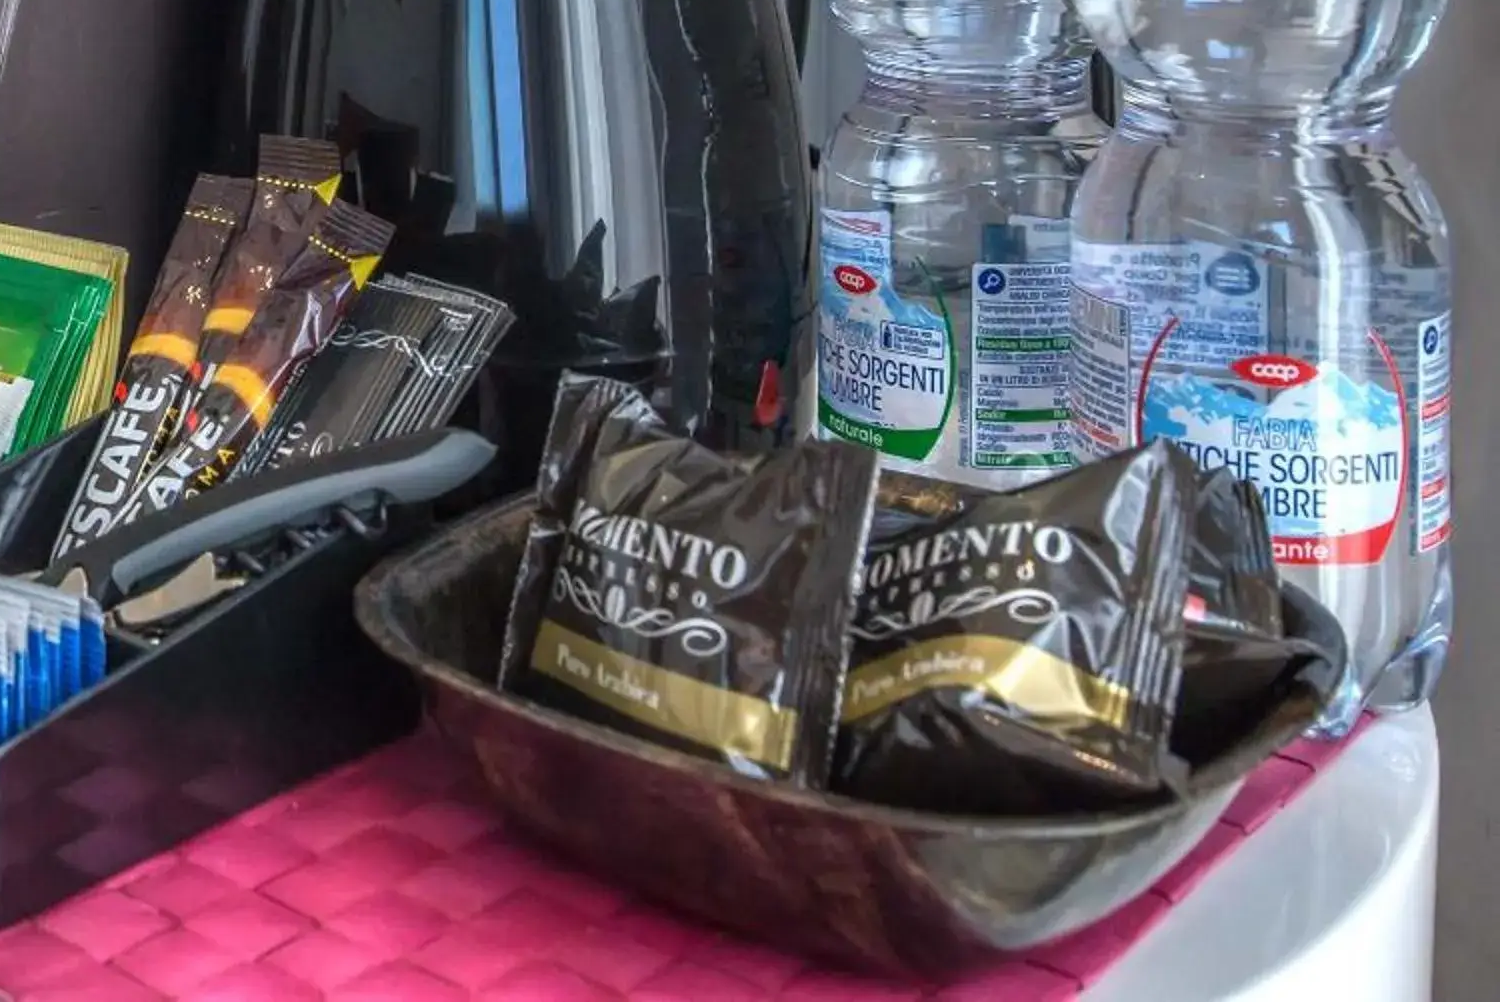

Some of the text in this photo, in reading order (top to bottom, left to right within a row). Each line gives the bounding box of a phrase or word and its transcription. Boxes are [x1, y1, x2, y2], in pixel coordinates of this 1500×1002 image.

[849, 349, 946, 396] SORGENTI
[1250, 362, 1301, 381] coop
[830, 370, 884, 413] UMBRE
[828, 413, 885, 449] naturale
[1180, 441, 1400, 486] TICHE SORGENTI
[1271, 541, 1331, 562] ante
